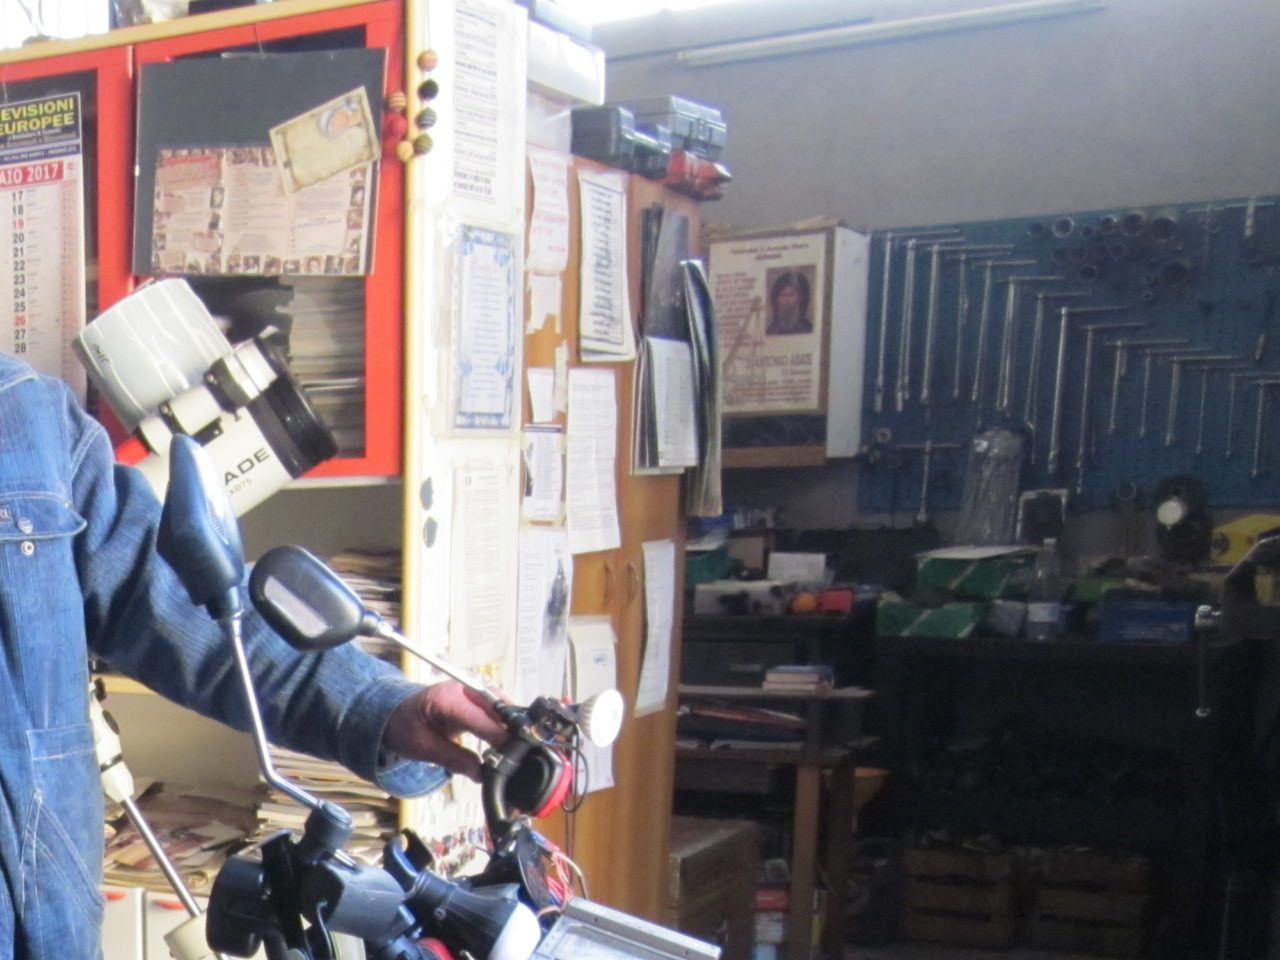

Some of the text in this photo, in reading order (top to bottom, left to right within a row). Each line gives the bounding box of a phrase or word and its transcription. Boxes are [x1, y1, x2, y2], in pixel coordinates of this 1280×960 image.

[27, 163, 59, 183] 2017
[12, 191, 24, 201] 17
[12, 205, 24, 215] 18
[13, 219, 24, 229] 19
[13, 233, 25, 244] 20
[13, 247, 24, 257] 21
[14, 261, 25, 271] 22
[14, 275, 25, 285] 23
[14, 288, 25, 299] 24
[14, 302, 26, 312] 25
[14, 315, 26, 326] 26
[14, 329, 26, 340] 27
[15, 343, 26, 353] 28
[224, 447, 270, 486] ADE
[228, 477, 253, 497] XD75
